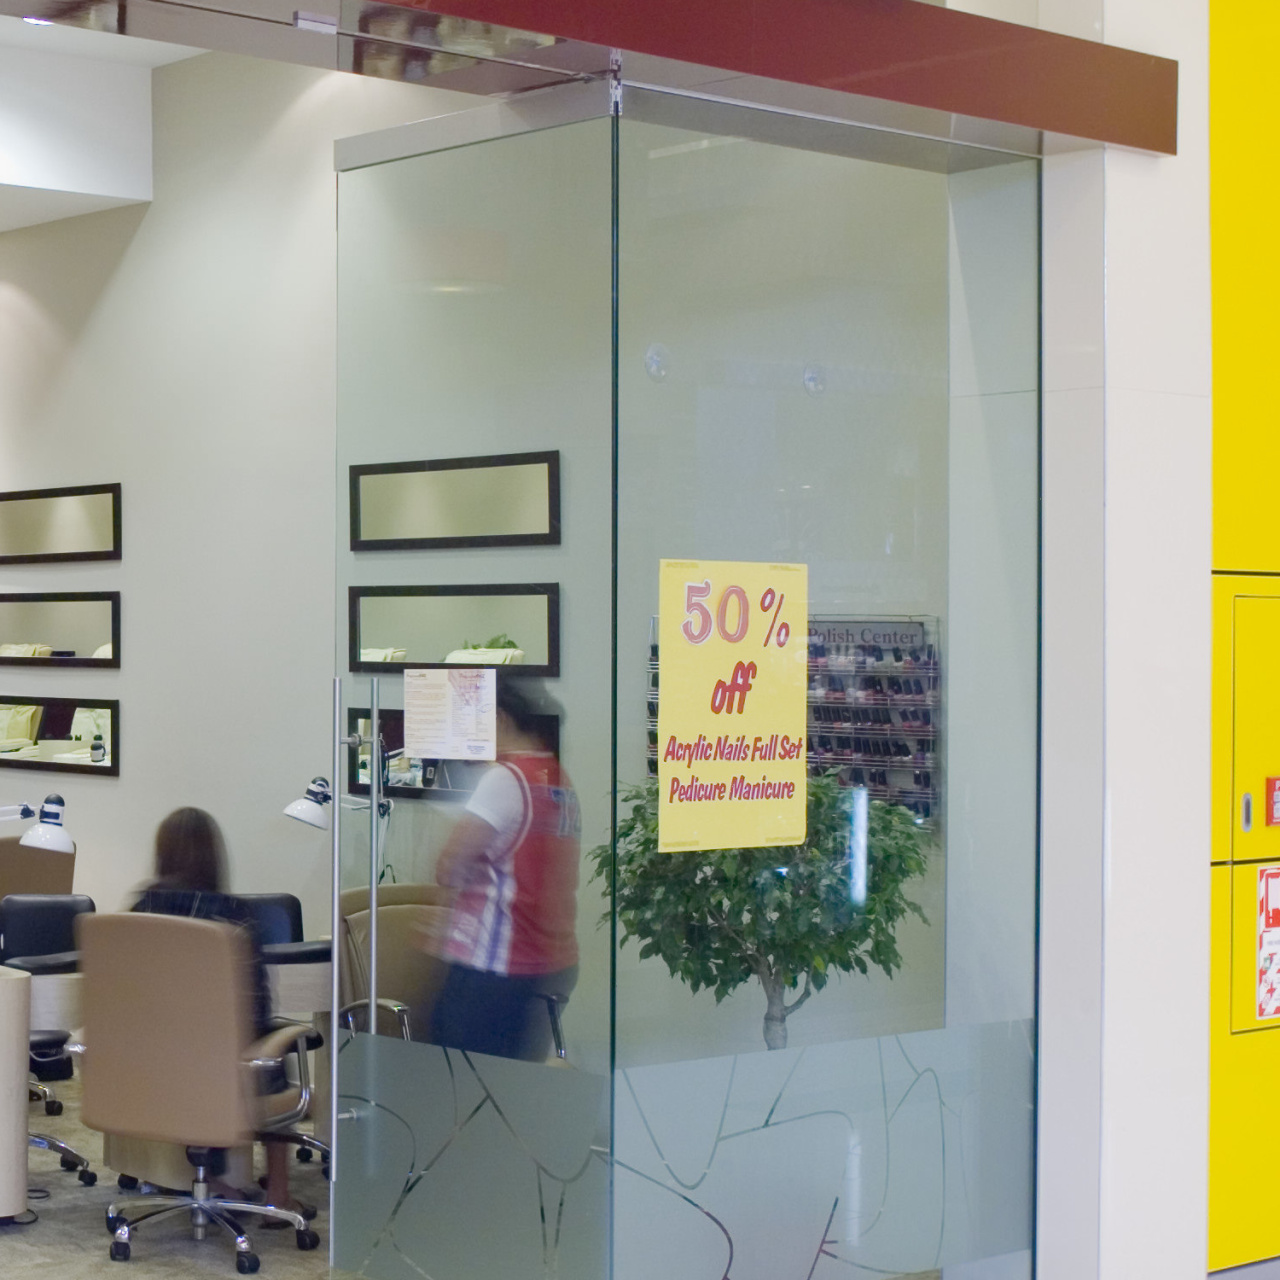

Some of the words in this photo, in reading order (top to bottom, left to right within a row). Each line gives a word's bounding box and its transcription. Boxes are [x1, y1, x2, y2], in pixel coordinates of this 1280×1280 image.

[860, 628, 918, 644] Center
[710, 660, 758, 714] off
[663, 733, 713, 769] Acrylic
[713, 734, 751, 762] Nails
[751, 733, 779, 762] Full
[778, 734, 803, 760] Set
[669, 774, 727, 804] Pedicure
[729, 774, 796, 801] Manicure
